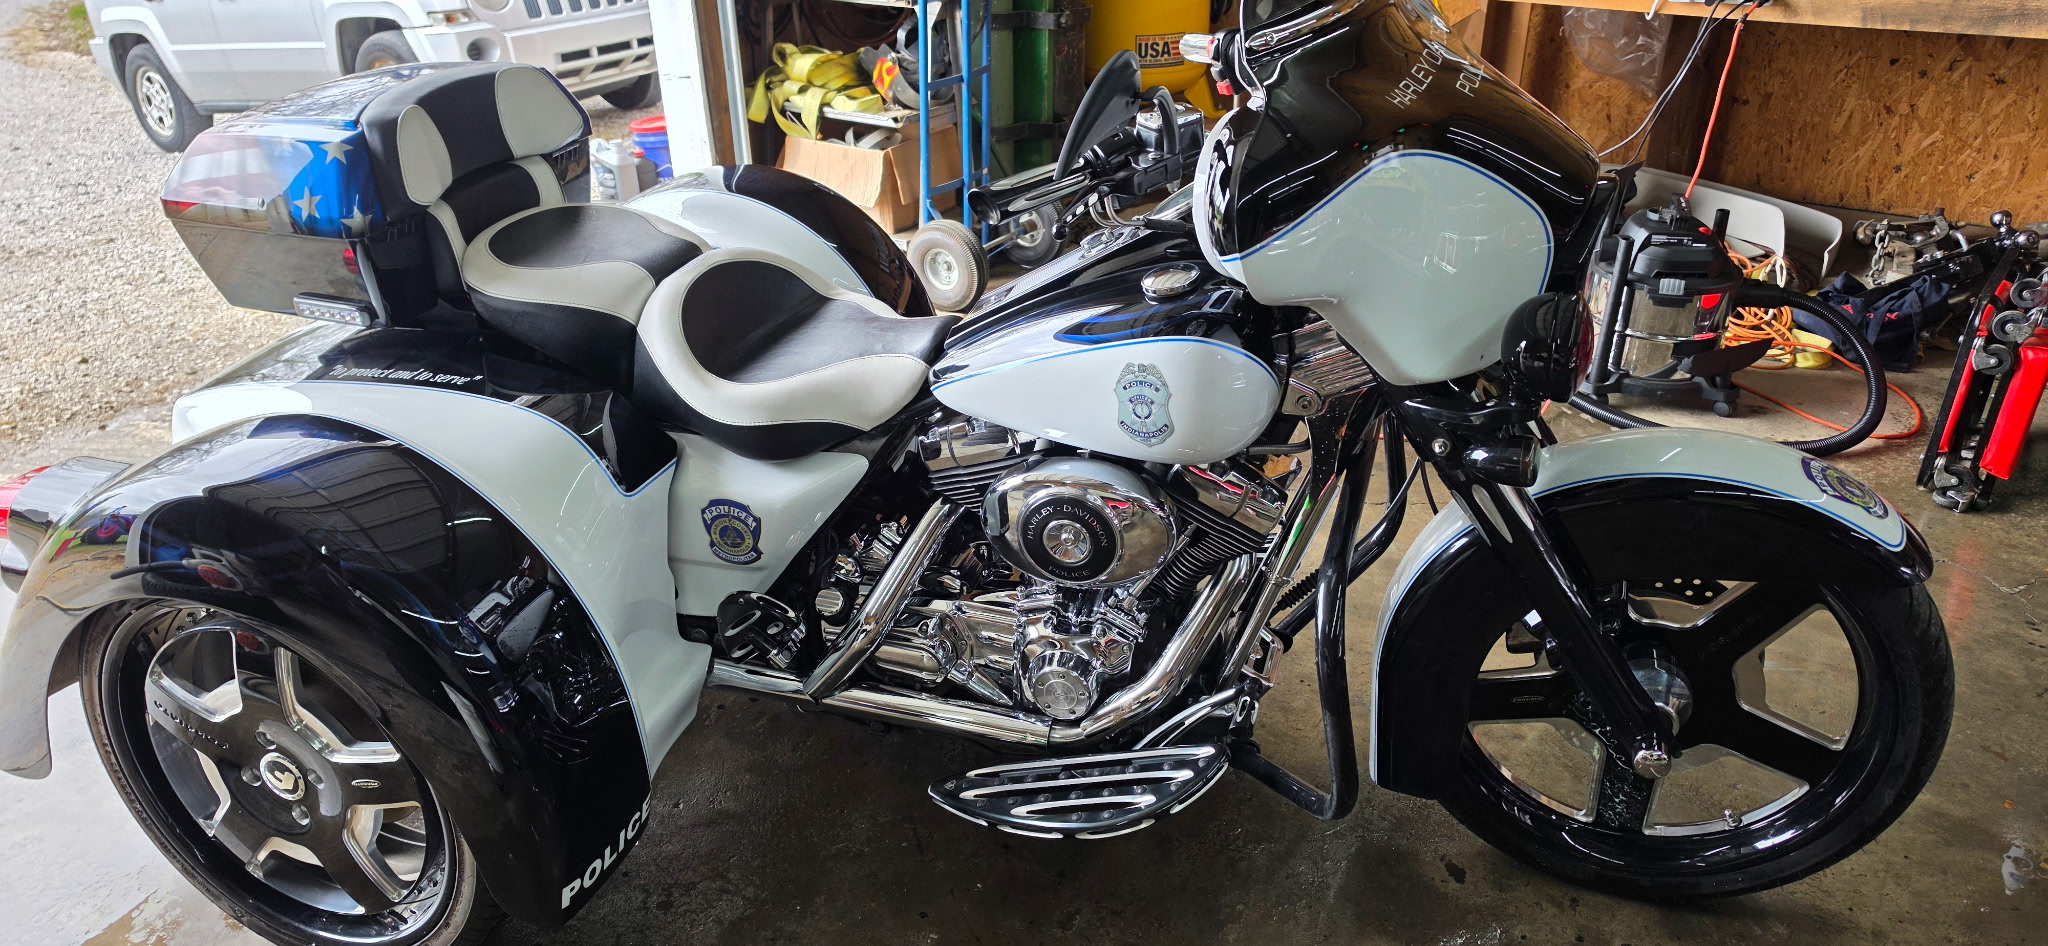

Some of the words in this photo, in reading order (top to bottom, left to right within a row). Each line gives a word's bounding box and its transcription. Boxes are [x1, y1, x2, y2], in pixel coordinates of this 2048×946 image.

[1138, 42, 1171, 58] USA
[1385, 57, 1436, 109] HARLEY
[337, 368, 395, 378] protect
[388, 369, 424, 379] and
[1125, 381, 1156, 392] POLICE
[1121, 422, 1168, 438] INDIANAPOLIS
[707, 506, 751, 523] POLICE
[732, 521, 751, 541] COUNTY
[1049, 565, 1091, 578] POLICE
[561, 790, 652, 909] POLICE
